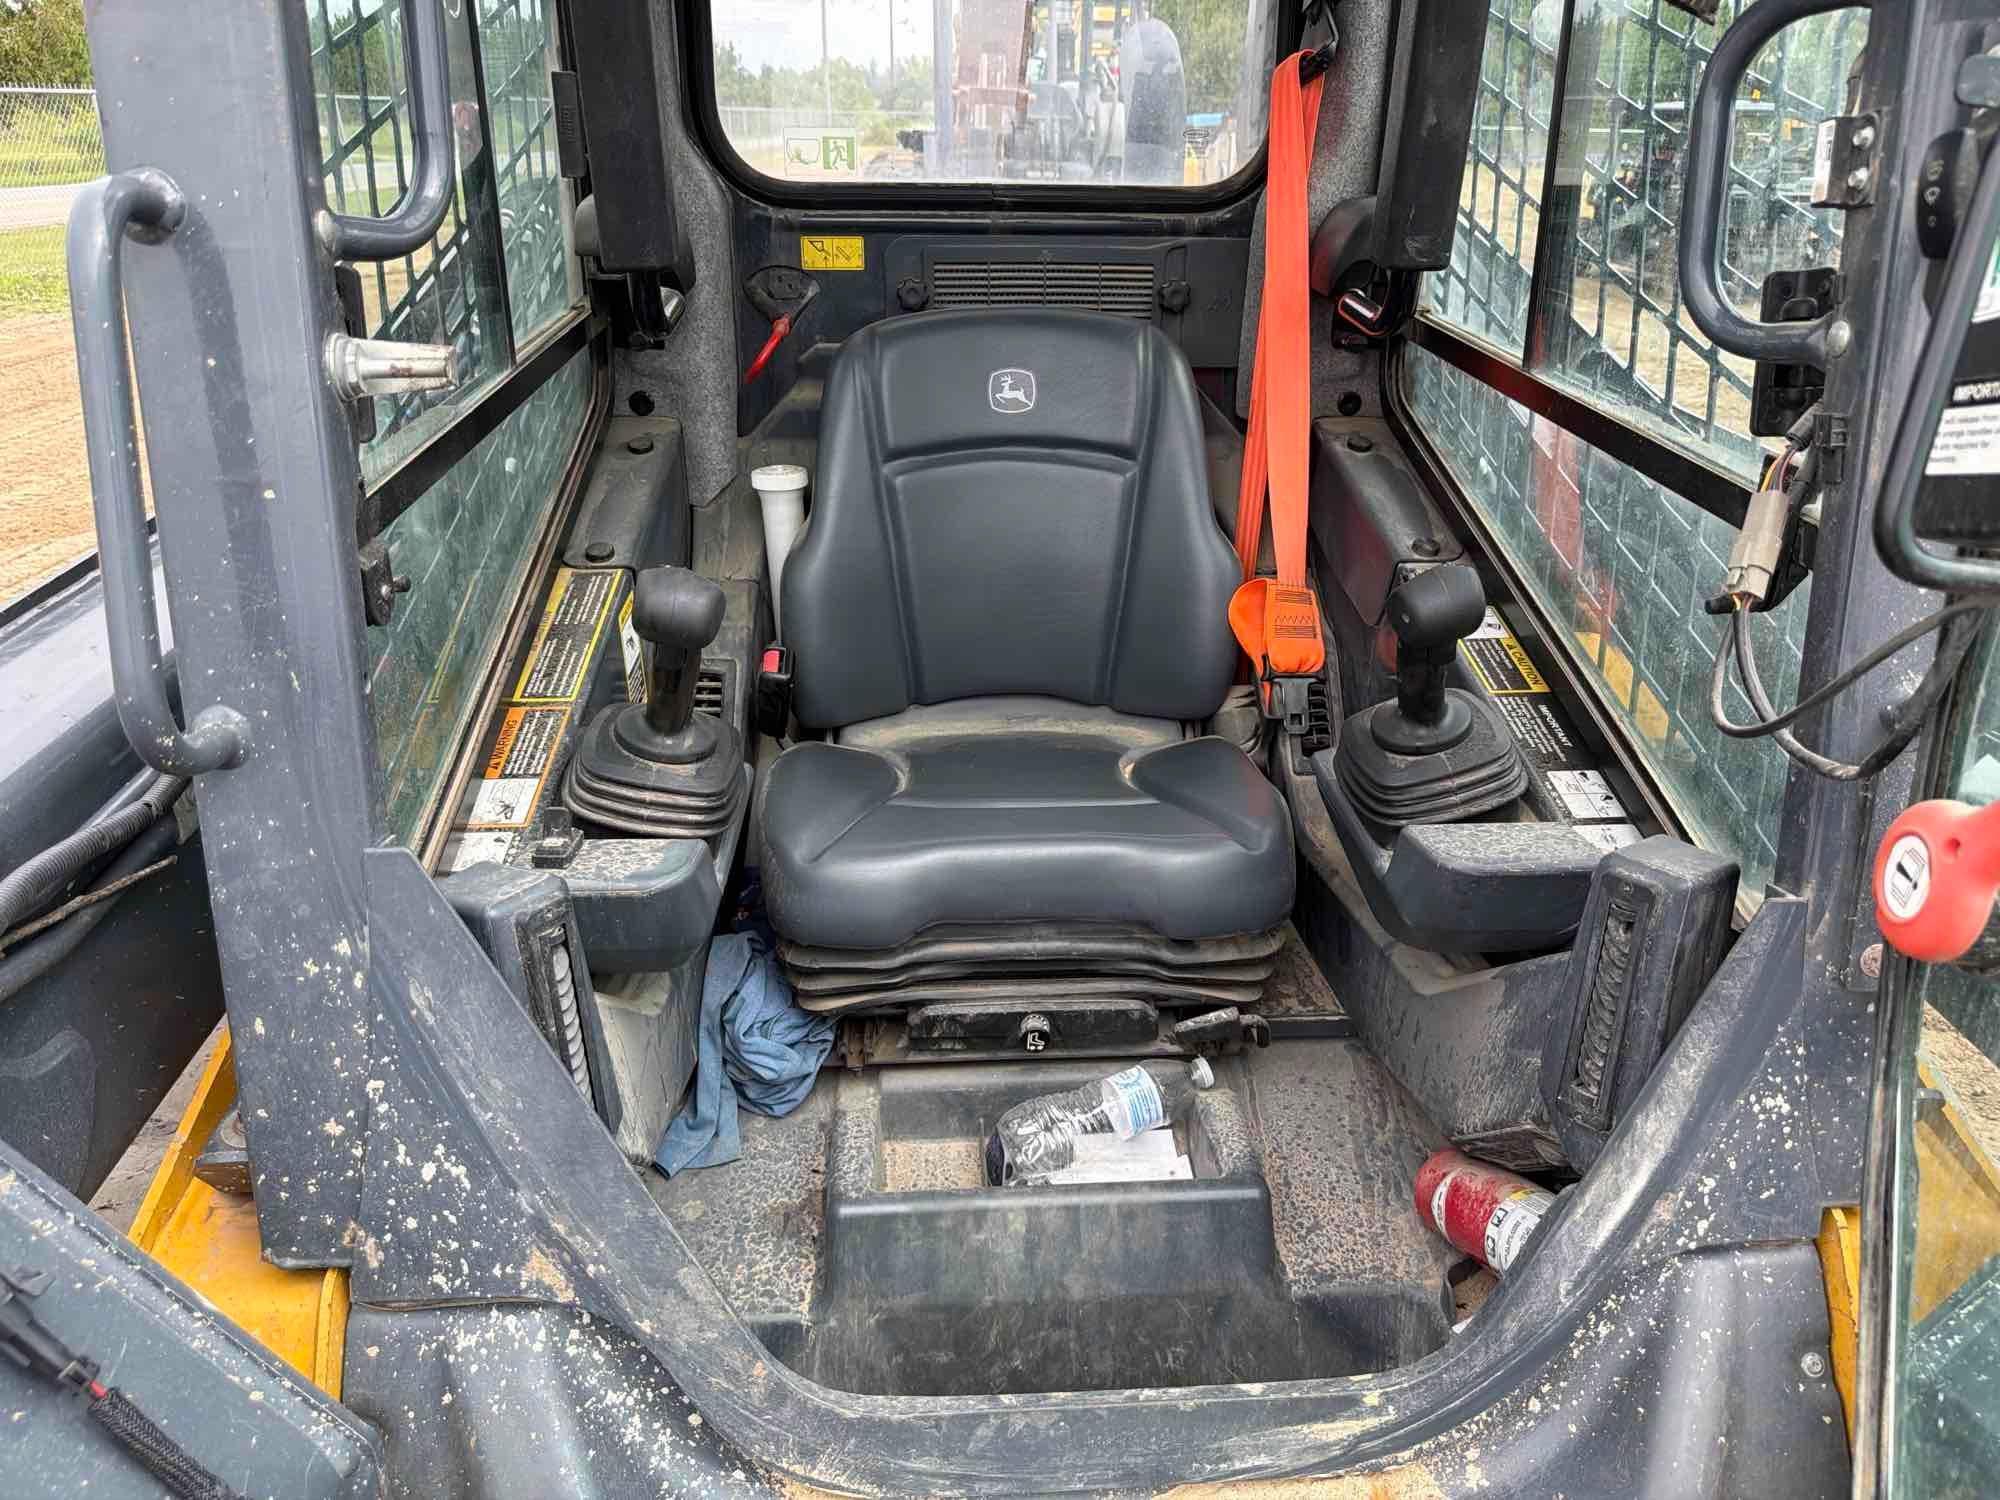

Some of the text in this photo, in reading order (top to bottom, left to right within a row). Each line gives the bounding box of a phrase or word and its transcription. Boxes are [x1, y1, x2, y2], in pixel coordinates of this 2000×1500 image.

[1511, 648, 1543, 687] CAUTION
[490, 719, 518, 760] WARNING
[1538, 704, 1573, 747] IMPORTANT
